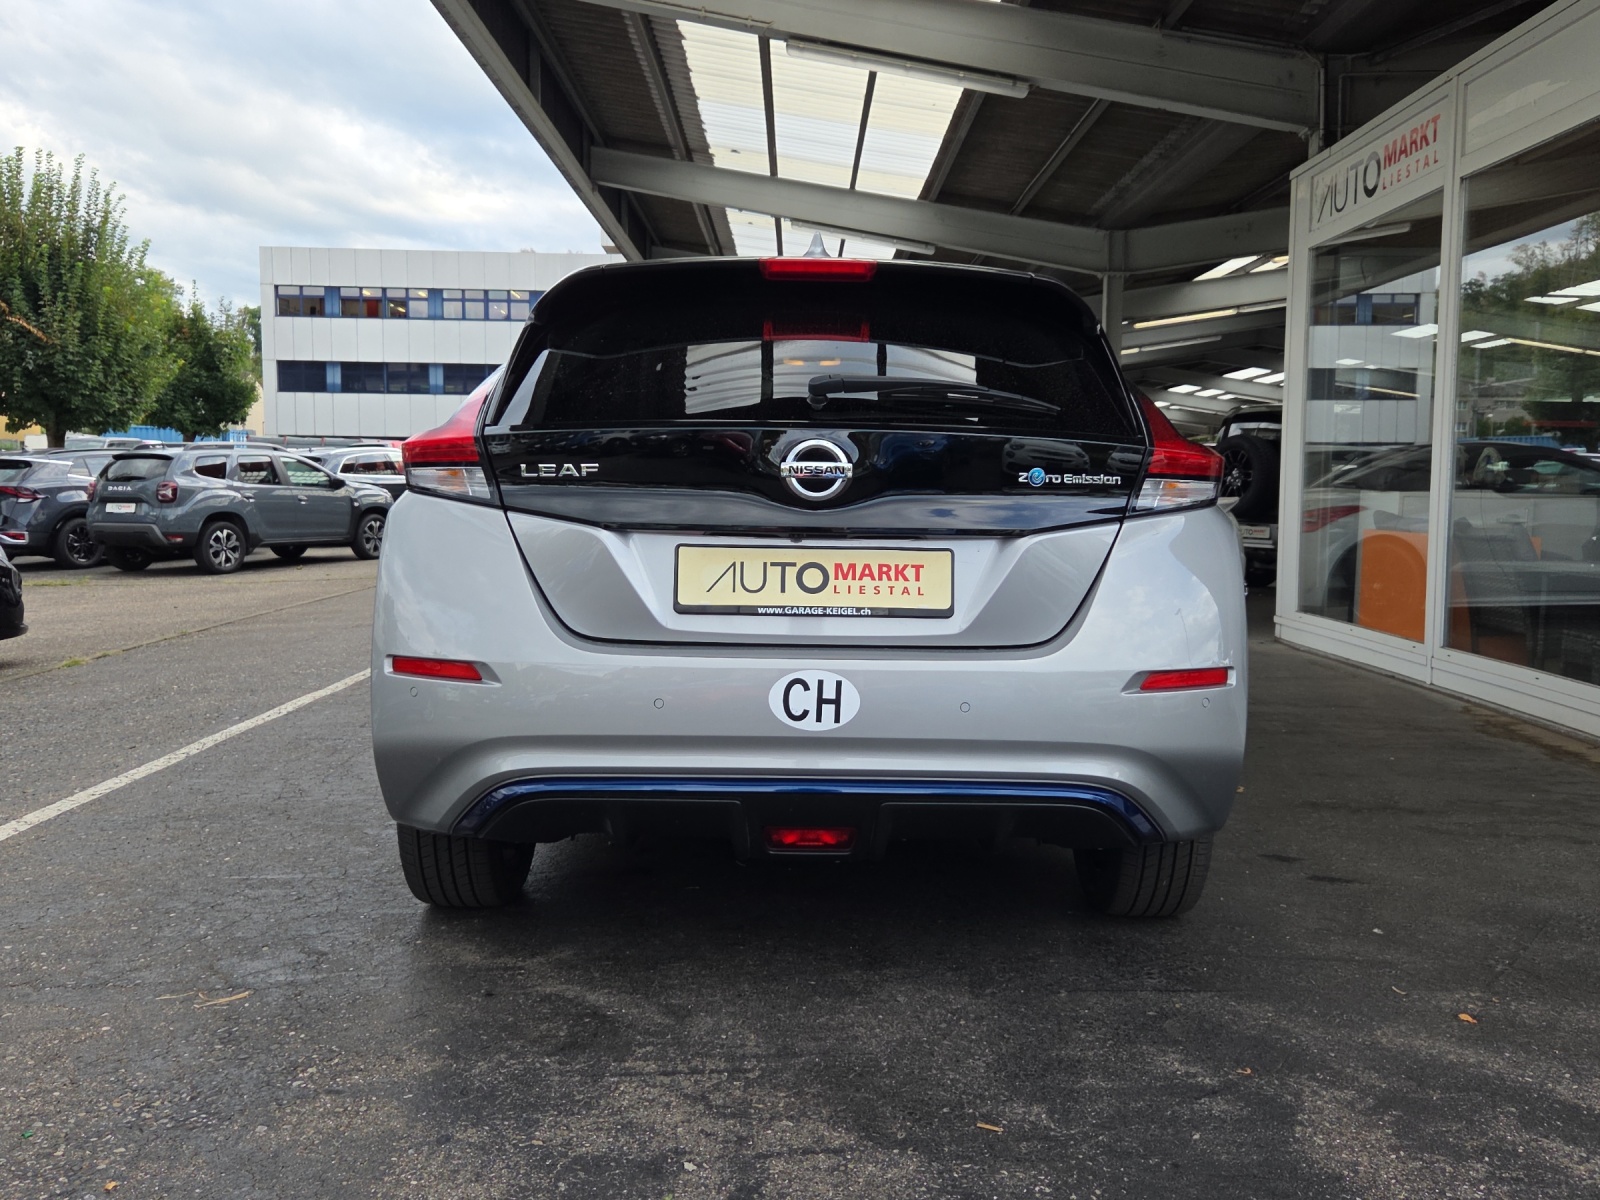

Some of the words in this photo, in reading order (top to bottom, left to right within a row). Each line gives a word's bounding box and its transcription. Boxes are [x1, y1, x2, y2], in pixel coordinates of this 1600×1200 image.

[1317, 151, 1381, 223] AUTO
[1383, 114, 1441, 170] MARKT
[1382, 150, 1439, 190] LIESTAL
[520, 463, 600, 478] LEAF
[788, 465, 846, 476] NISSAN
[1063, 473, 1122, 485] Emission
[706, 561, 830, 594] AUTO
[834, 563, 924, 582] MARKT
[833, 585, 924, 596] LIESTAL
[757, 606, 872, 616] www.GARAGE-KEIGEL.ch
[782, 677, 843, 724] CH
